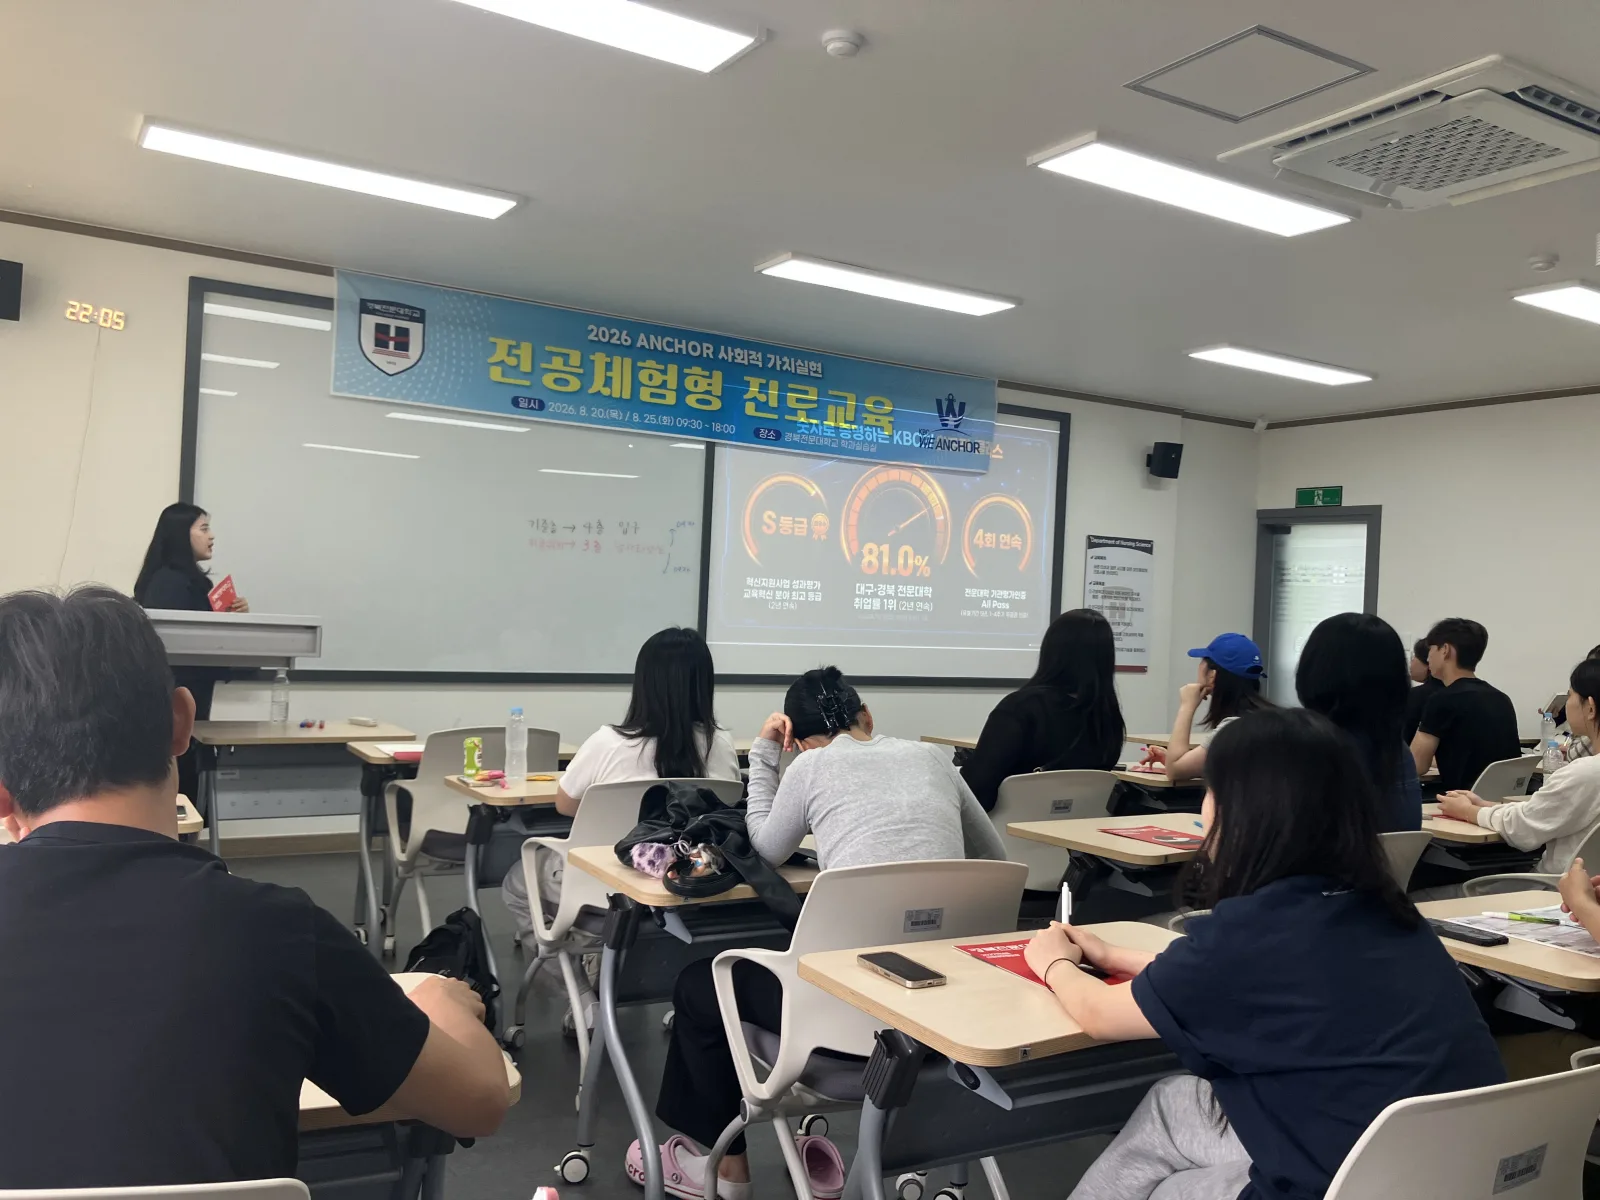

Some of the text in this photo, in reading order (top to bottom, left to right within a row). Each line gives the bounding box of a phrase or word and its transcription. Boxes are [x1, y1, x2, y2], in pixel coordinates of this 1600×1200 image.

[65, 300, 125, 331] 22:05
[587, 324, 822, 378] 2026 ANCHOR 사회적 가치실현
[487, 336, 894, 436] 전공체험형 진로교육
[518, 397, 538, 410] 일시
[548, 401, 576, 415] 2026.
[579, 406, 588, 417] 8.
[591, 407, 623, 421] 20.(목)
[632, 412, 641, 423] 8.
[644, 413, 674, 427] 25.(화)
[676, 417, 702, 430] 09:30
[712, 421, 735, 434] 18:00
[759, 428, 776, 440] 장소
[784, 432, 839, 448] 경북전문대학교
[919, 435, 936, 449] WE
[935, 438, 981, 454] ANCHOR
[973, 528, 1023, 550] 4회 연속
[861, 542, 931, 577] 81.0%
[897, 584, 932, 598] 전문대학
[853, 597, 933, 612] 취업률 1위 (2년 연속)
[981, 599, 1010, 609] All Pass
